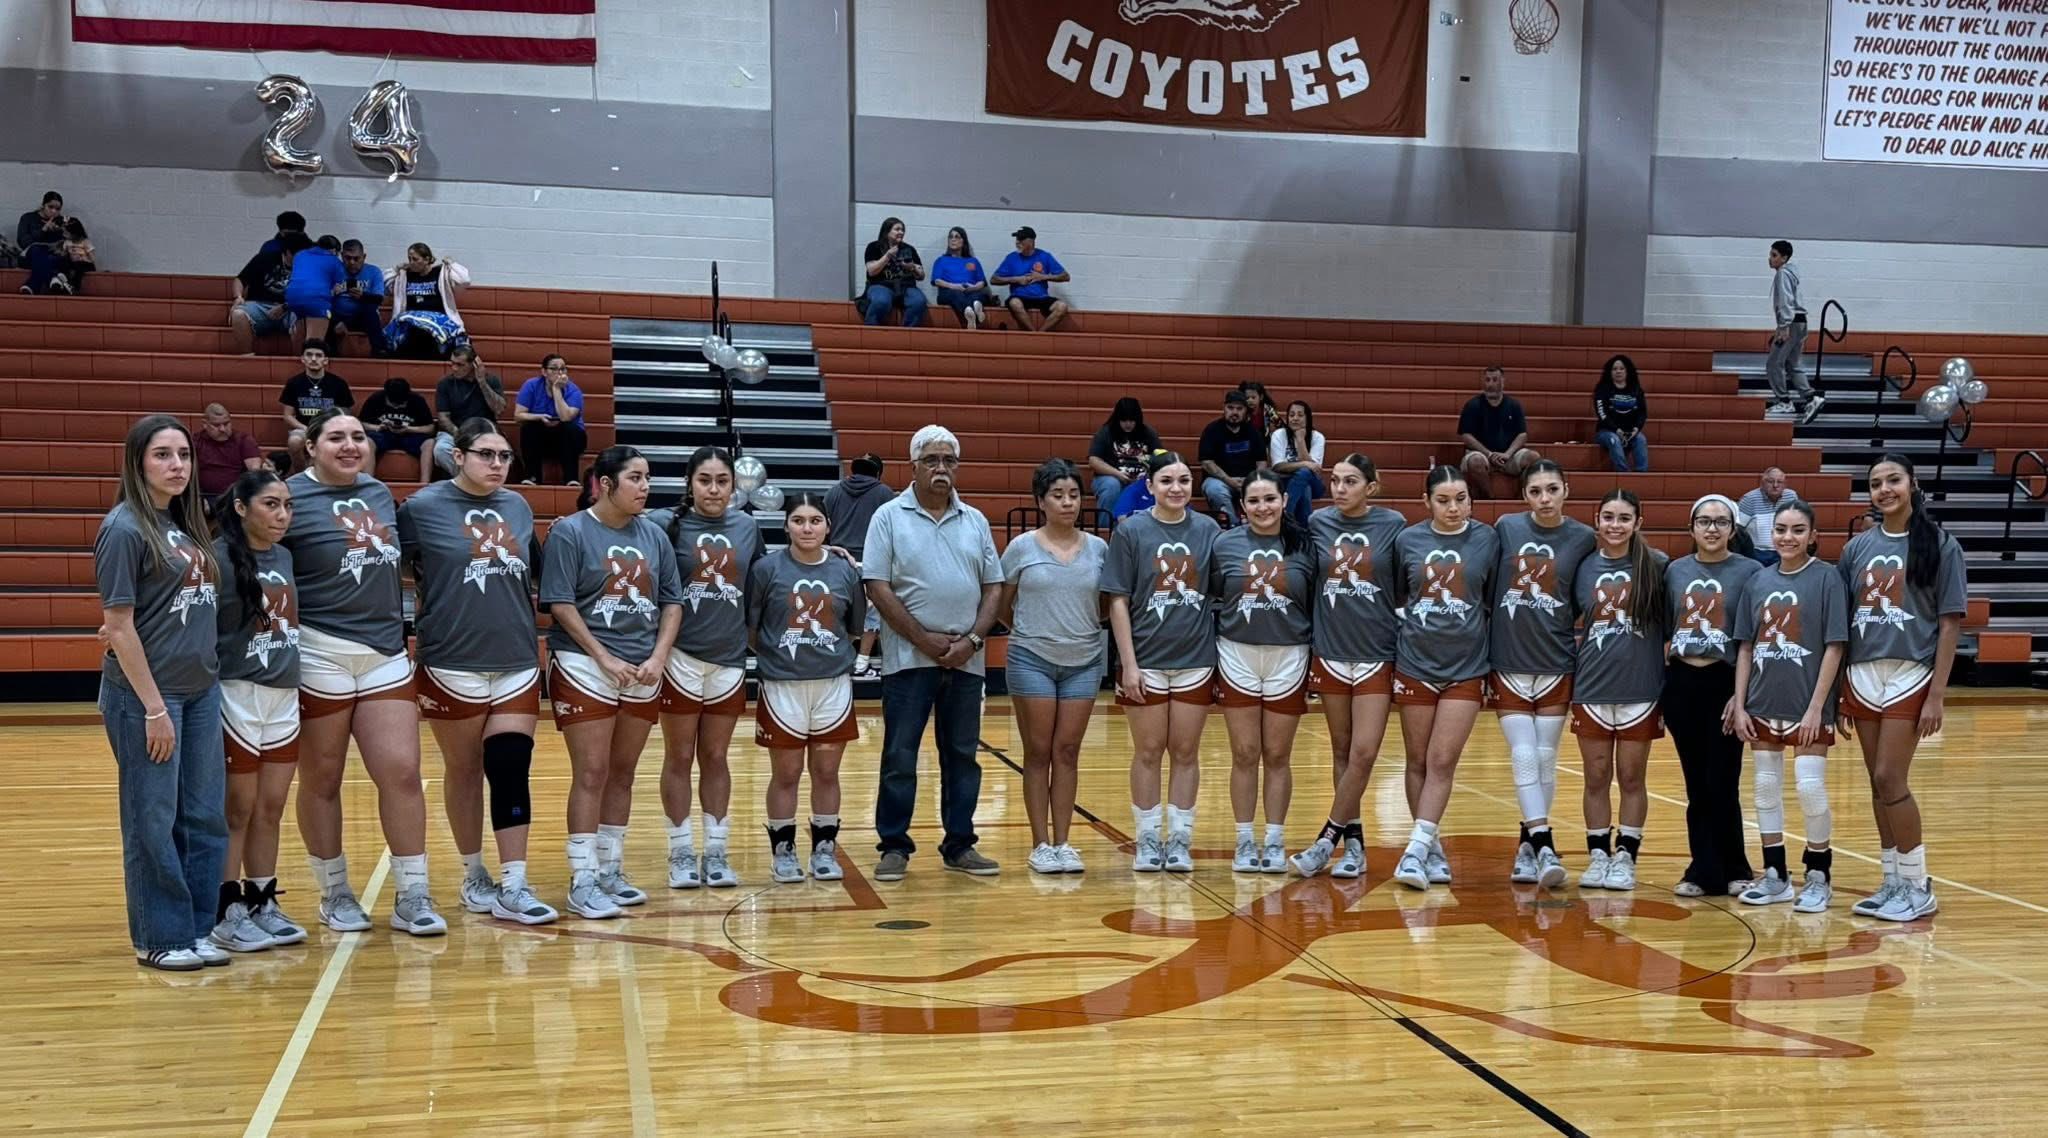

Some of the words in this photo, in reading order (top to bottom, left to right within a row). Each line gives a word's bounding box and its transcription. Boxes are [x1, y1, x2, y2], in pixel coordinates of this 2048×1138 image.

[1866, 11, 1916, 31] WE'VE
[1919, 15, 1955, 33] MET
[1958, 17, 2000, 36] WE'LL
[2005, 20, 2037, 38] NOT
[1853, 36, 1959, 58] THROUGHOUT
[1962, 41, 1992, 60] THE
[1047, 19, 1370, 116] COYOTES
[1830, 59, 1853, 78] SO
[1855, 61, 1913, 81] HERE'S
[1917, 64, 1936, 82] TO
[1940, 65, 1970, 84] THE
[1973, 66, 2039, 87] ORANGE
[1847, 85, 1878, 103] THE
[1881, 87, 1943, 107] COLORS
[1946, 90, 1977, 108] FOR
[1981, 91, 2034, 111] WHICH
[1833, 109, 1877, 128] LET'S
[1878, 111, 1936, 131] PLEDGE
[1937, 114, 1988, 133] ANEW
[1988, 116, 2023, 134] AND
[1882, 136, 1902, 154] TO
[1904, 137, 1947, 156] DEAR
[1949, 139, 1982, 157] OLD
[1983, 140, 2028, 160] ALICE
